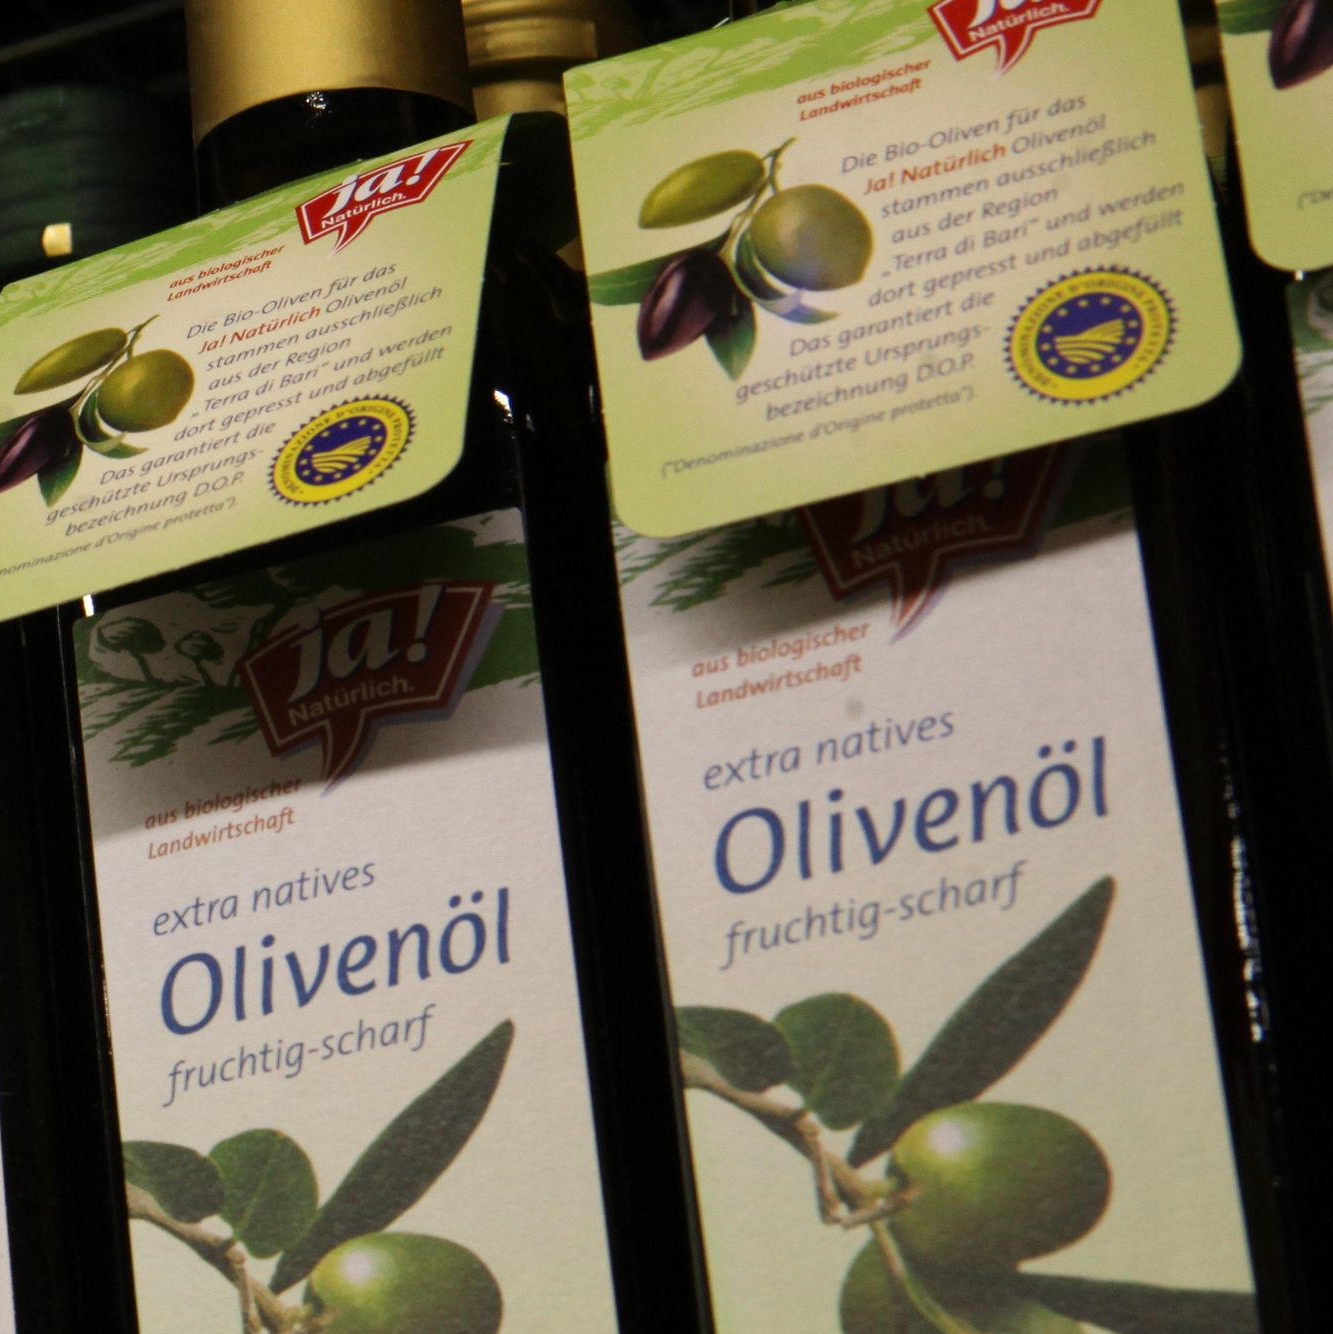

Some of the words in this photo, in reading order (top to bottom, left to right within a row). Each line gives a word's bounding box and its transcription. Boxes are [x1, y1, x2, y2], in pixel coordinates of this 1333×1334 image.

[323, 146, 439, 220] ja!
[901, 142, 1006, 185] Natürlich
[881, 178, 989, 218] stammen
[981, 183, 1059, 225] Region
[166, 259, 272, 303] Landwirtschaft
[197, 244, 285, 283] biologischer
[186, 318, 220, 341] Die
[223, 285, 323, 329] Bio-Oliven
[363, 262, 397, 285] das
[206, 334, 302, 372] stammen
[306, 287, 443, 338] ausschließlich
[232, 305, 321, 345] Natürlich
[324, 276, 409, 316] Olivenöl
[284, 338, 352, 374] Region
[376, 326, 453, 367] werden
[220, 395, 303, 438] gepresst
[353, 346, 445, 390] abgefüllt
[99, 461, 136, 487] Das
[138, 434, 240, 482] garantiert
[46, 479, 152, 527] geschützte
[65, 491, 189, 538] bezeichnung
[691, 653, 730, 678] aus
[736, 620, 872, 669] biologischer
[695, 652, 864, 710] Landwirtschaft
[703, 740, 801, 792] extra
[816, 710, 956, 767] natives
[184, 777, 303, 820] biologischer
[713, 734, 1109, 896] Olivenöl
[148, 806, 296, 860] Landwirtschaft
[153, 889, 238, 936] extra
[252, 861, 377, 913] natives
[720, 859, 1028, 971] fruchtig-scharf
[159, 887, 511, 1036] Olivenöl
[160, 1003, 435, 1107] fruchtig-scharf
